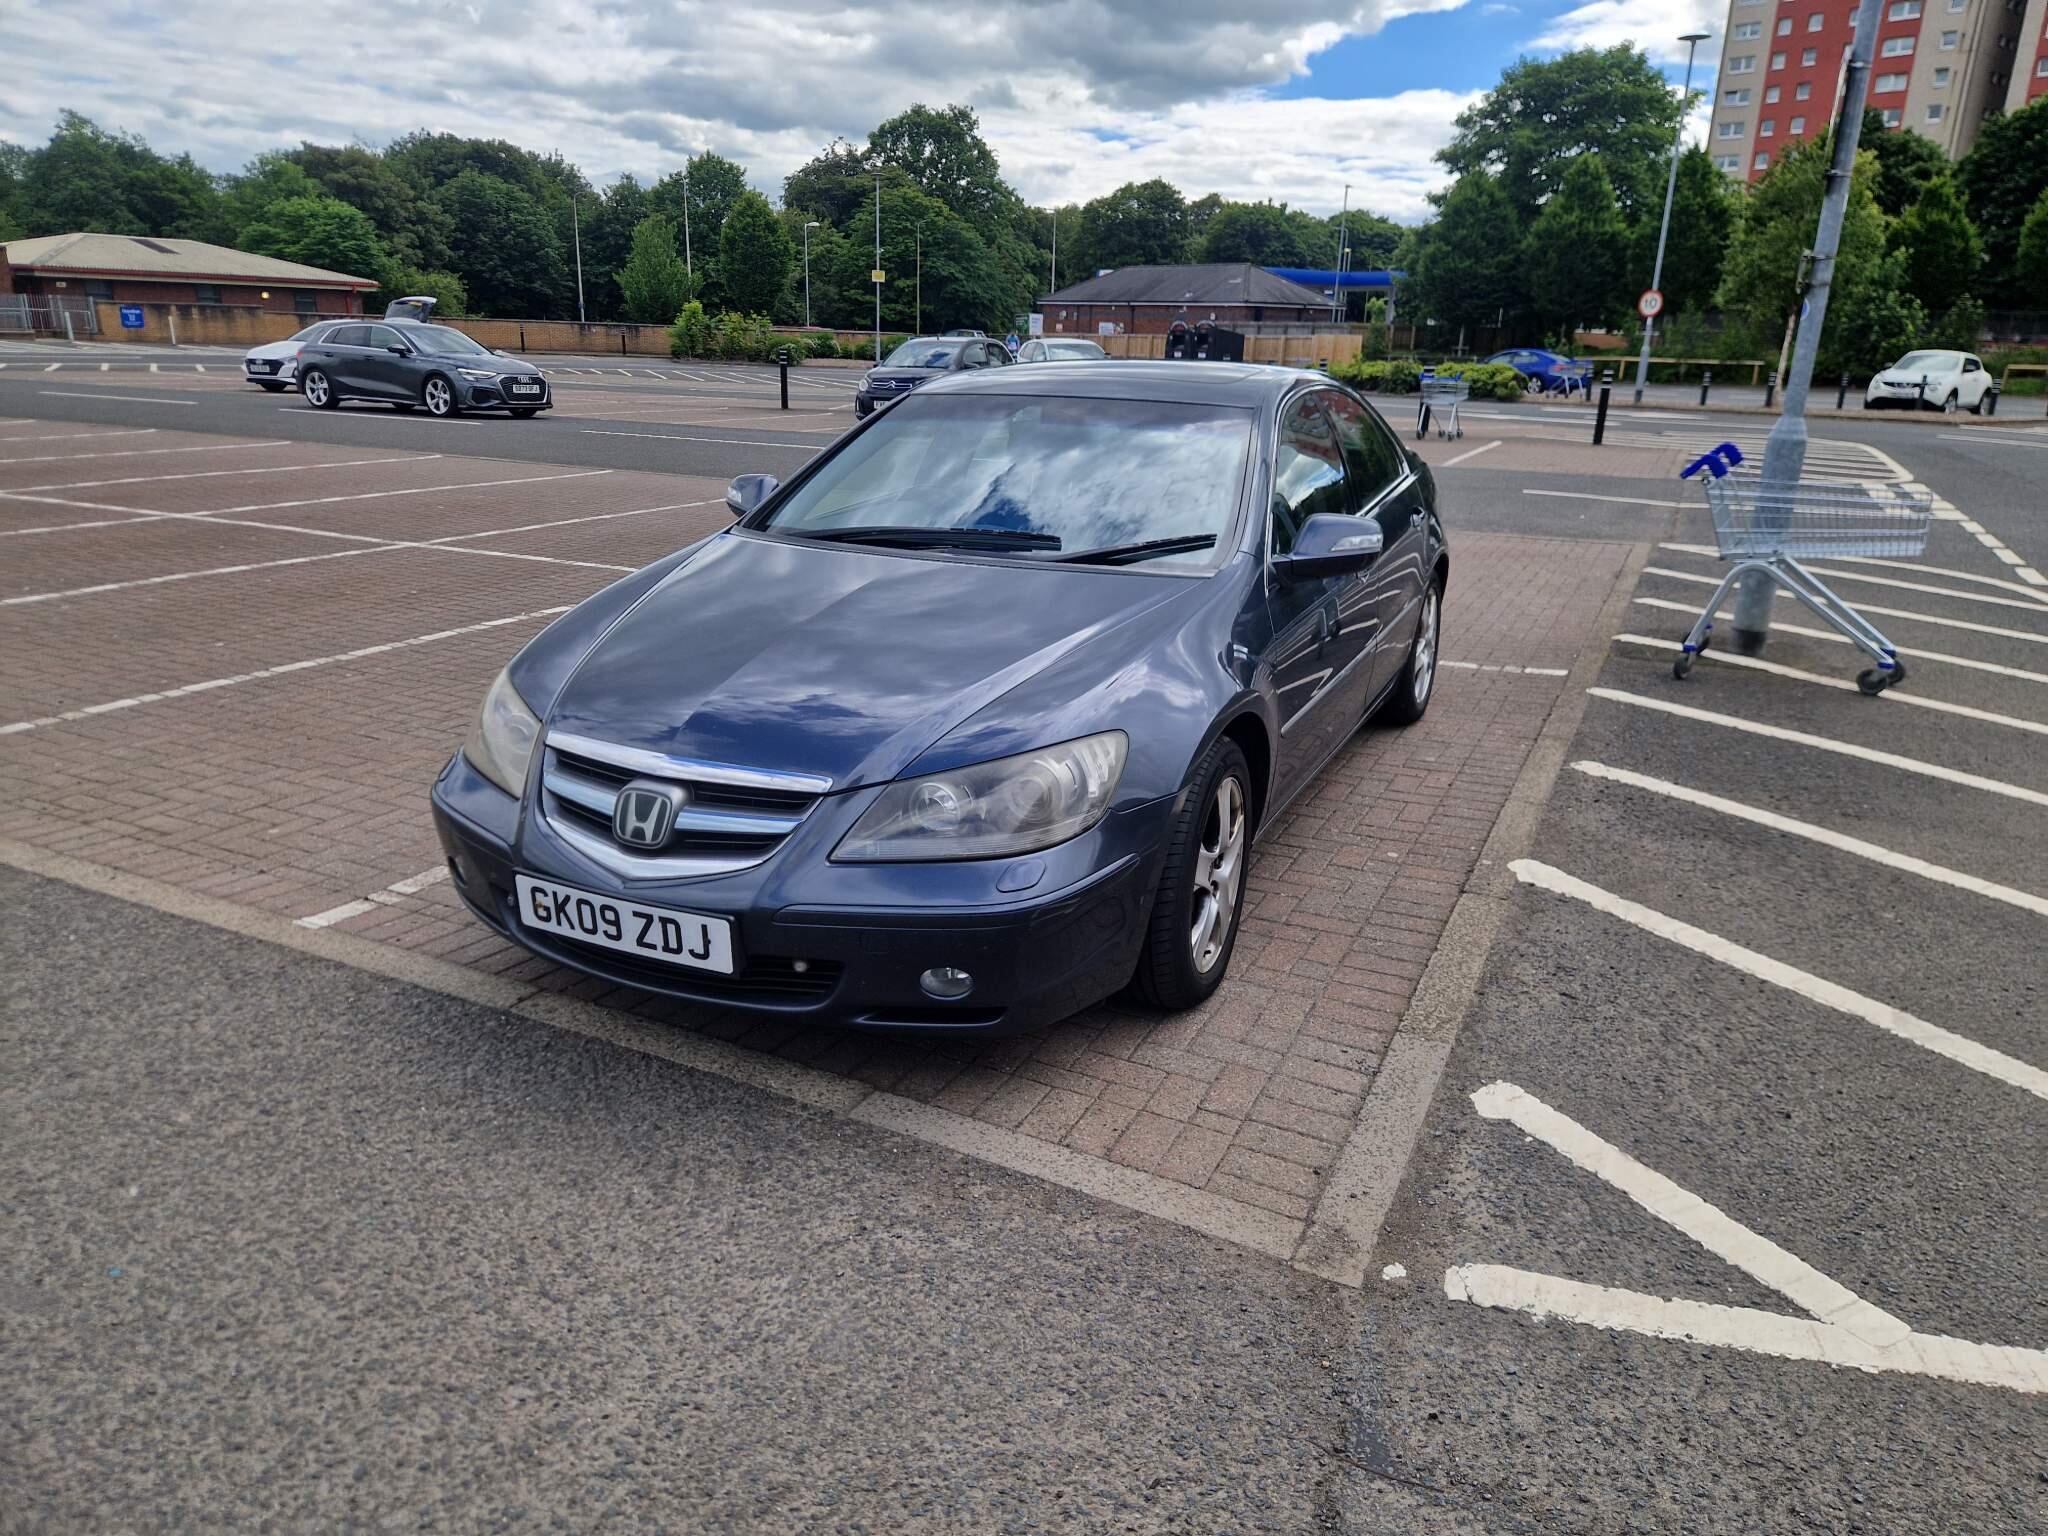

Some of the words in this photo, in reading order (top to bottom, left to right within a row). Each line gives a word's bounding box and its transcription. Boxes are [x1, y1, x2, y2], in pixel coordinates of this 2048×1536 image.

[1644, 296, 1657, 309] 10
[530, 886, 623, 942] GK09
[632, 910, 711, 961] ZDJ
